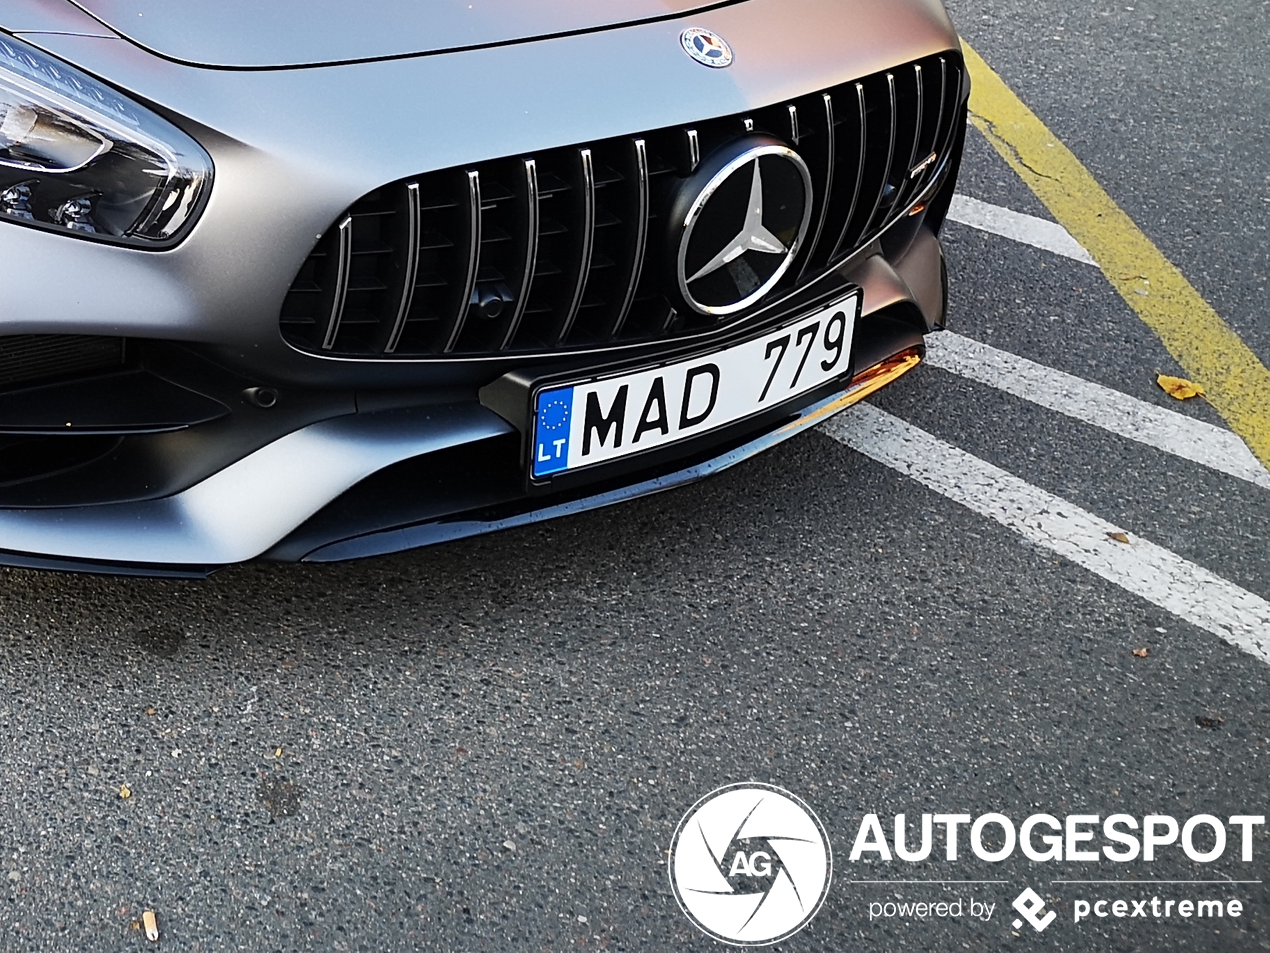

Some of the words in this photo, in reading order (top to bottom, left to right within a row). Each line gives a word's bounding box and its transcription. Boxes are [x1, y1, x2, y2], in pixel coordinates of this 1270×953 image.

[581, 362, 721, 457] MAD
[758, 310, 847, 403] 779
[537, 437, 566, 463] LT
